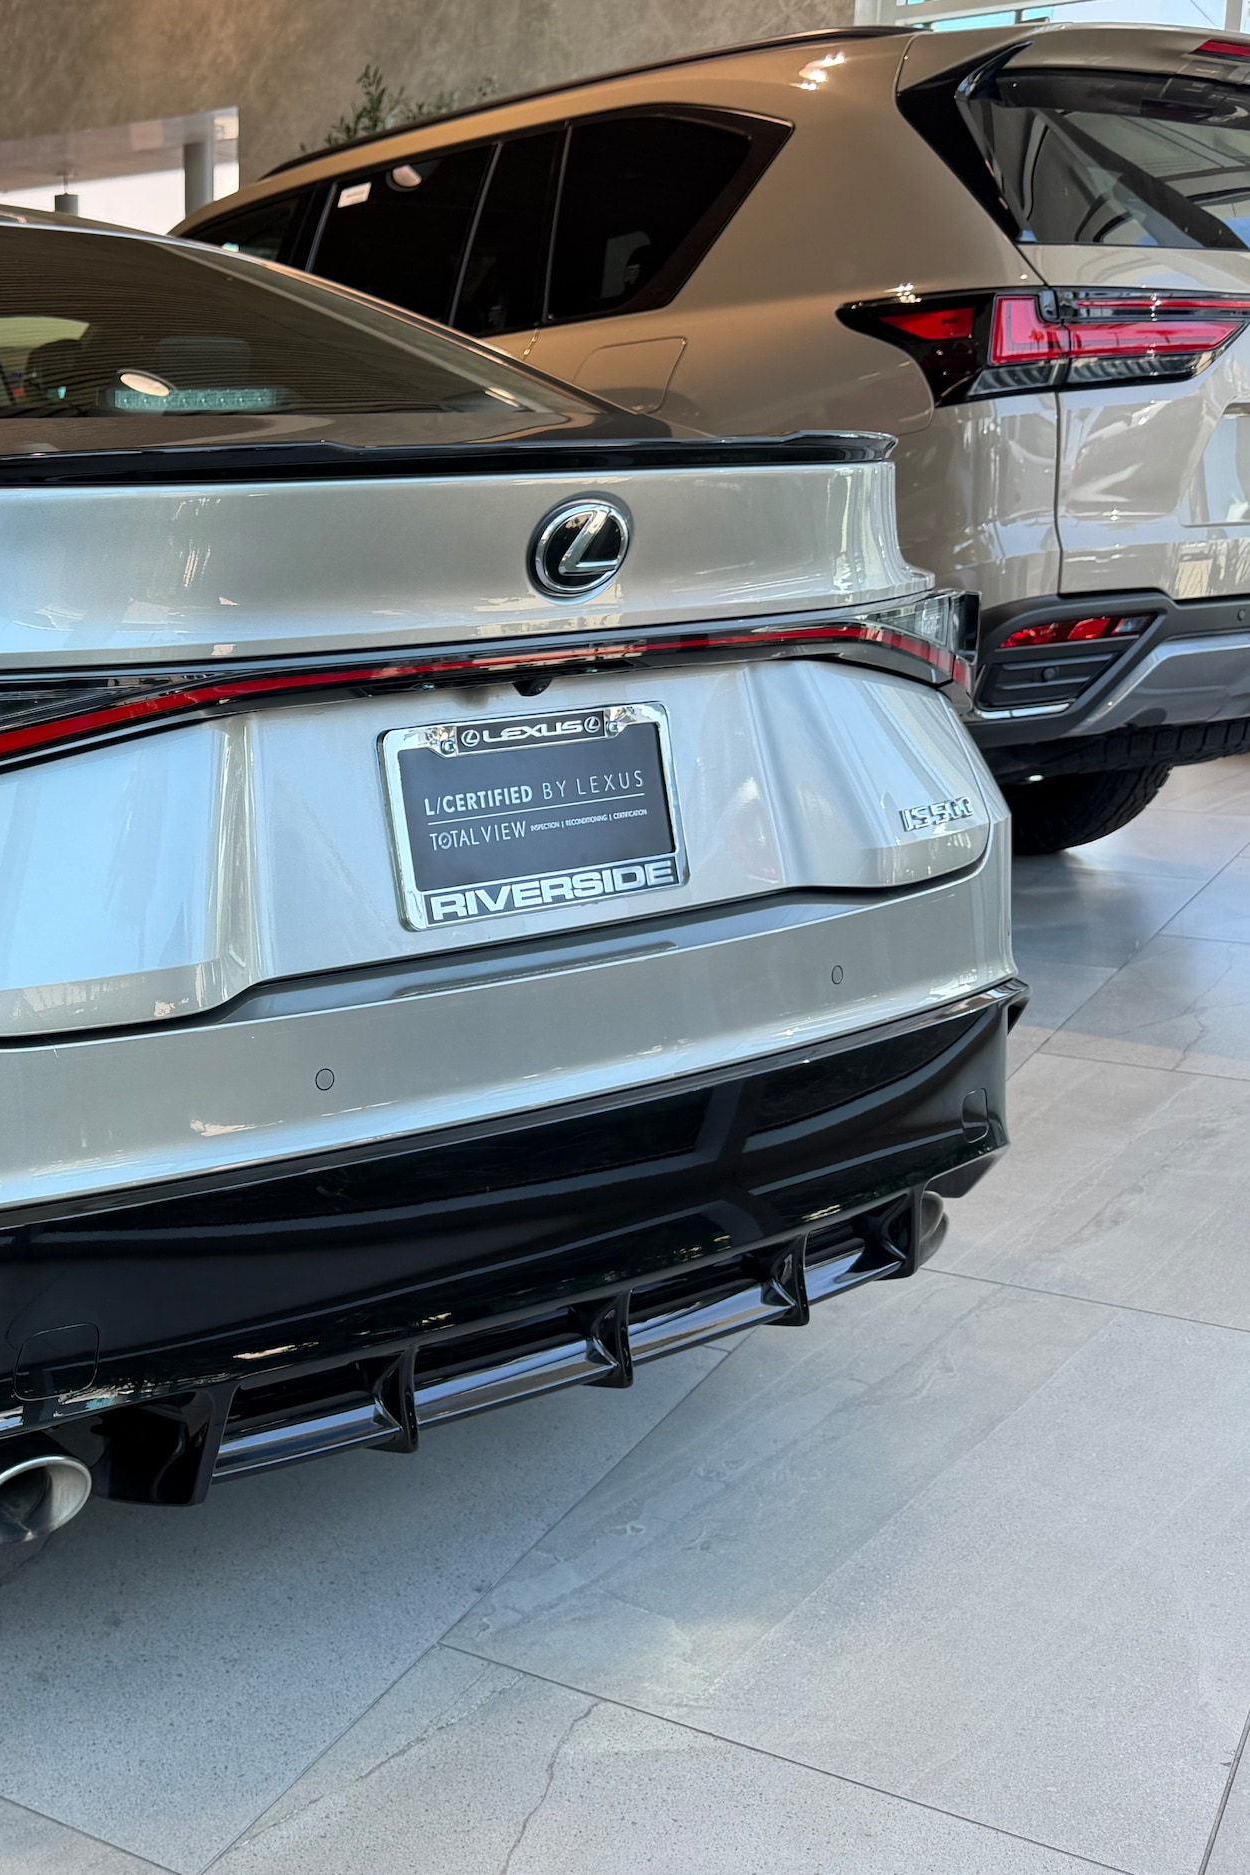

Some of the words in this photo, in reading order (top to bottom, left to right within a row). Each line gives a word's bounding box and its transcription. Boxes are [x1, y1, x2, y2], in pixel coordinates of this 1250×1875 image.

[482, 719, 583, 744] LEXUS
[542, 780, 566, 800] BY
[576, 770, 644, 796] LEXUS
[431, 860, 675, 921] RIVERSIDE
